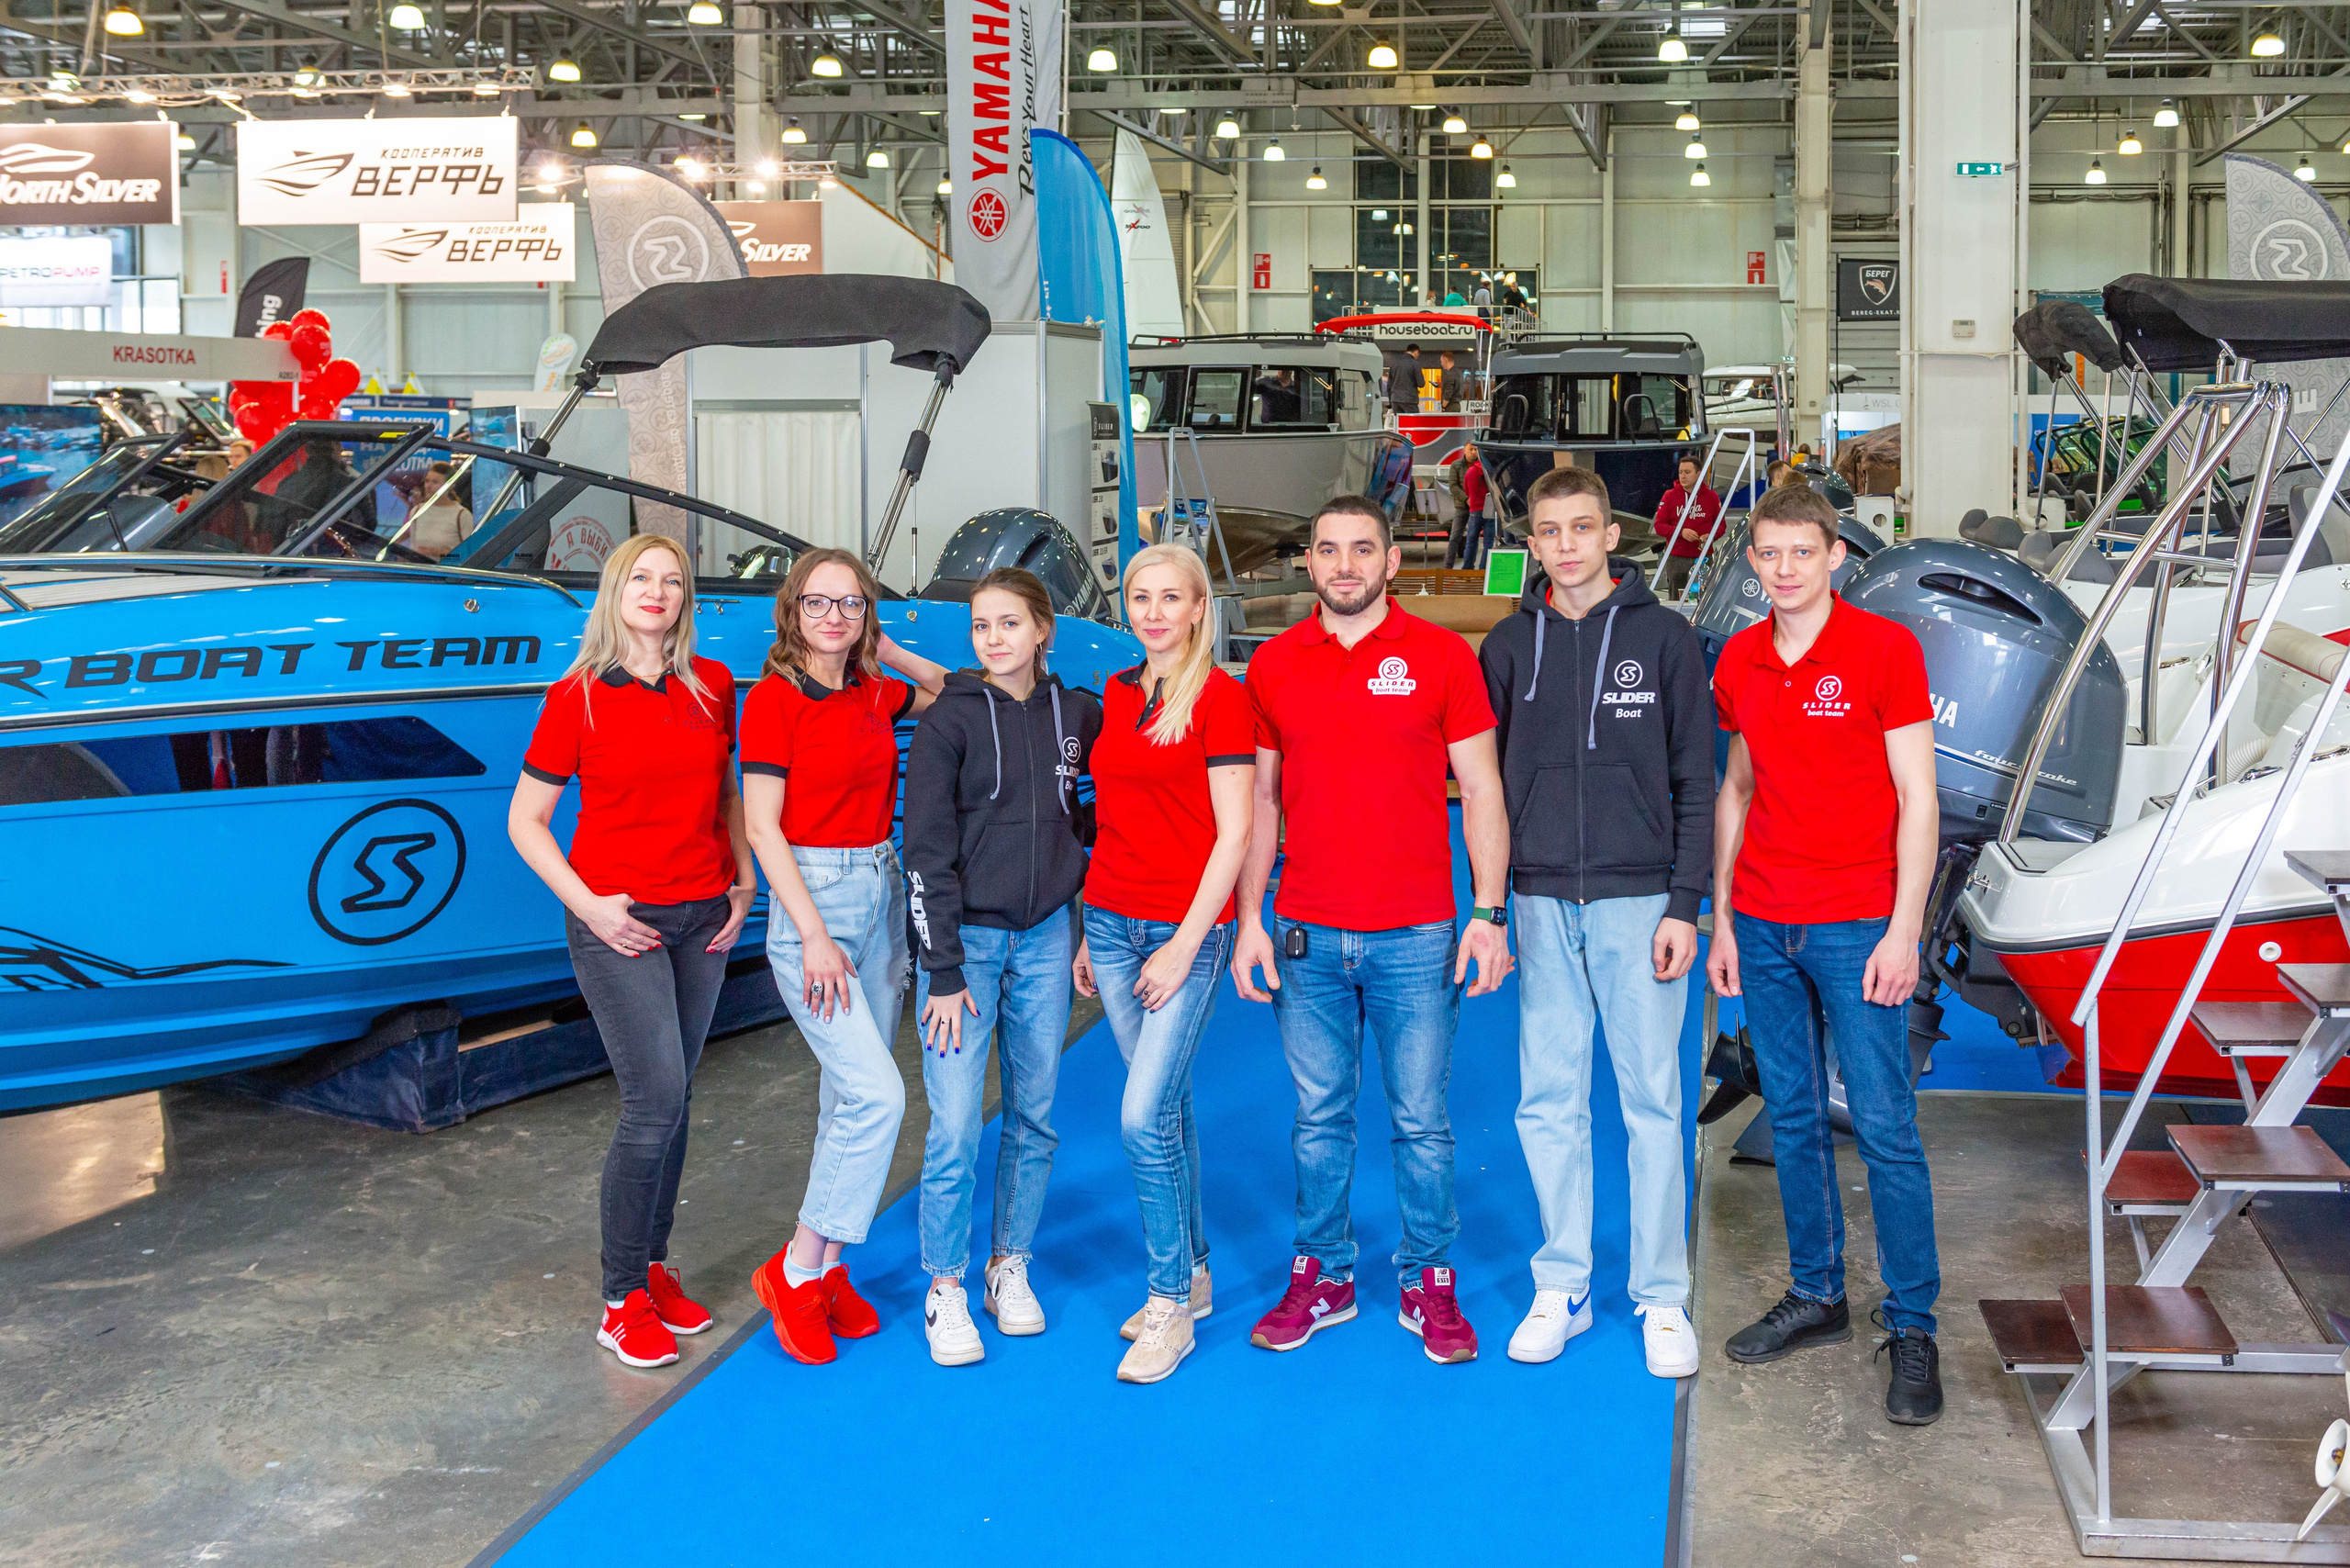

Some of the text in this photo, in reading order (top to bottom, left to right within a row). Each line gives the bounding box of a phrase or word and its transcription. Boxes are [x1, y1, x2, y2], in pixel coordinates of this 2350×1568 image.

[380, 147, 484, 159] КООПЕРАТИВ
[350, 164, 504, 196] ВЕРФЬ
[468, 226, 547, 234] КООПЕРАТИВ
[445, 239, 563, 262] ВЕРФЬ
[739, 237, 811, 263] SILVER
[1379, 323, 1472, 335] houseboat.ru
[113, 346, 196, 364] KRASOTKA
[64, 642, 317, 689] BOAT
[333, 635, 542, 672] TEAM
[1602, 692, 1656, 704] SLIDER
[1802, 701, 1852, 710] SLIDER
[1616, 708, 1642, 718] Boat
